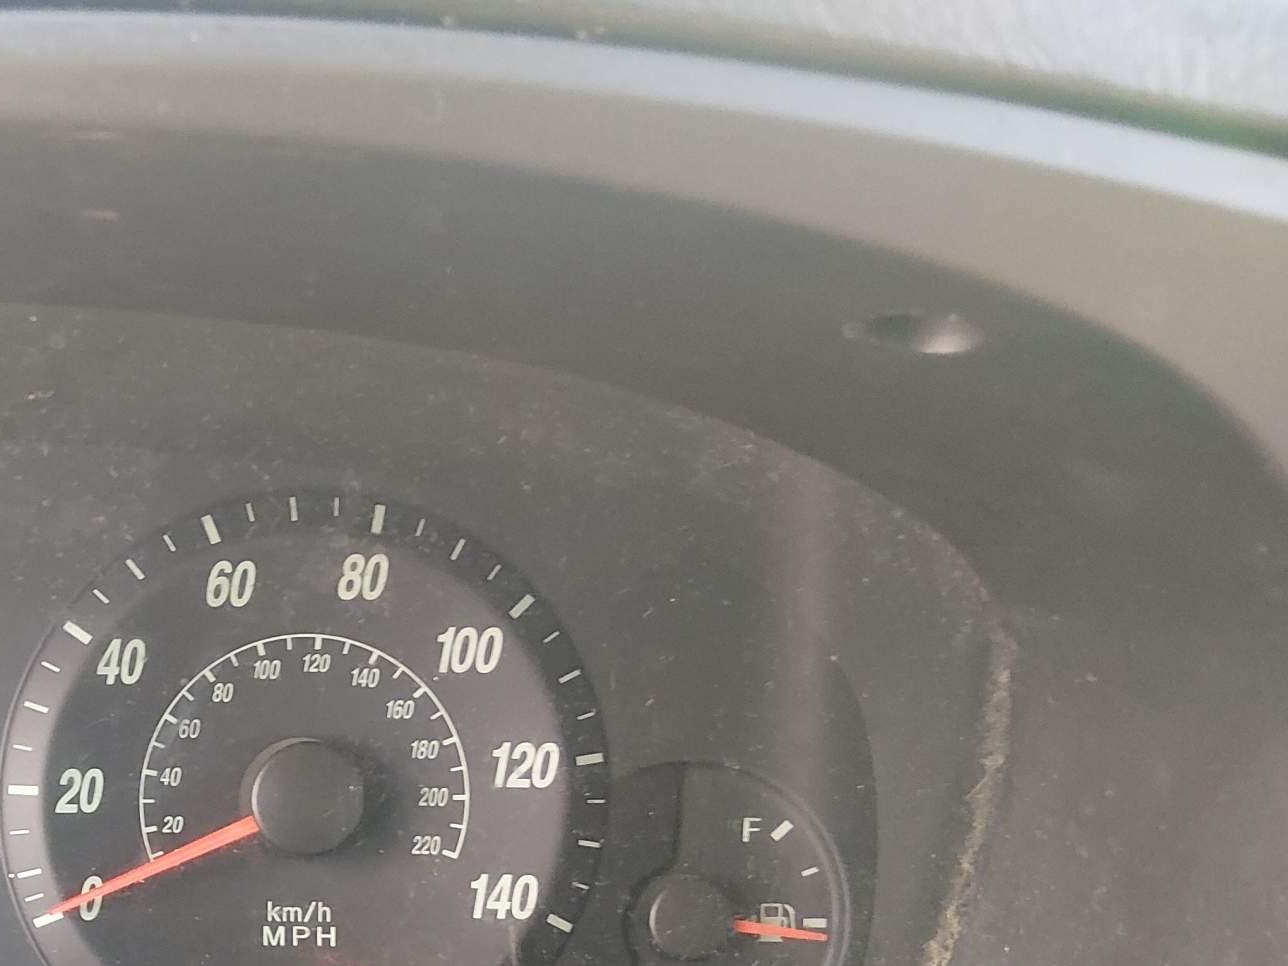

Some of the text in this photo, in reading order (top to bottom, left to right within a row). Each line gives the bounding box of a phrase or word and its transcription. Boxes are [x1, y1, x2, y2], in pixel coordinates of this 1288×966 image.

[206, 560, 257, 608] 60
[337, 553, 389, 601] 80
[436, 626, 504, 674] 100
[96, 638, 146, 686] 40
[252, 659, 281, 681] 100
[302, 653, 331, 673] 120
[351, 667, 380, 689] 140
[212, 683, 234, 703] 80
[385, 699, 415, 721] 160
[178, 719, 201, 739] 60
[410, 739, 440, 760] 180
[491, 742, 560, 790] 120
[160, 767, 182, 788] 40
[55, 768, 104, 814] 20
[418, 787, 449, 807] 200
[161, 815, 185, 834] 20
[742, 817, 761, 842] F
[412, 835, 442, 856] 220
[79, 875, 104, 921] 0
[470, 873, 539, 920] 140
[266, 901, 332, 924] km/h
[262, 926, 337, 948] MPH
